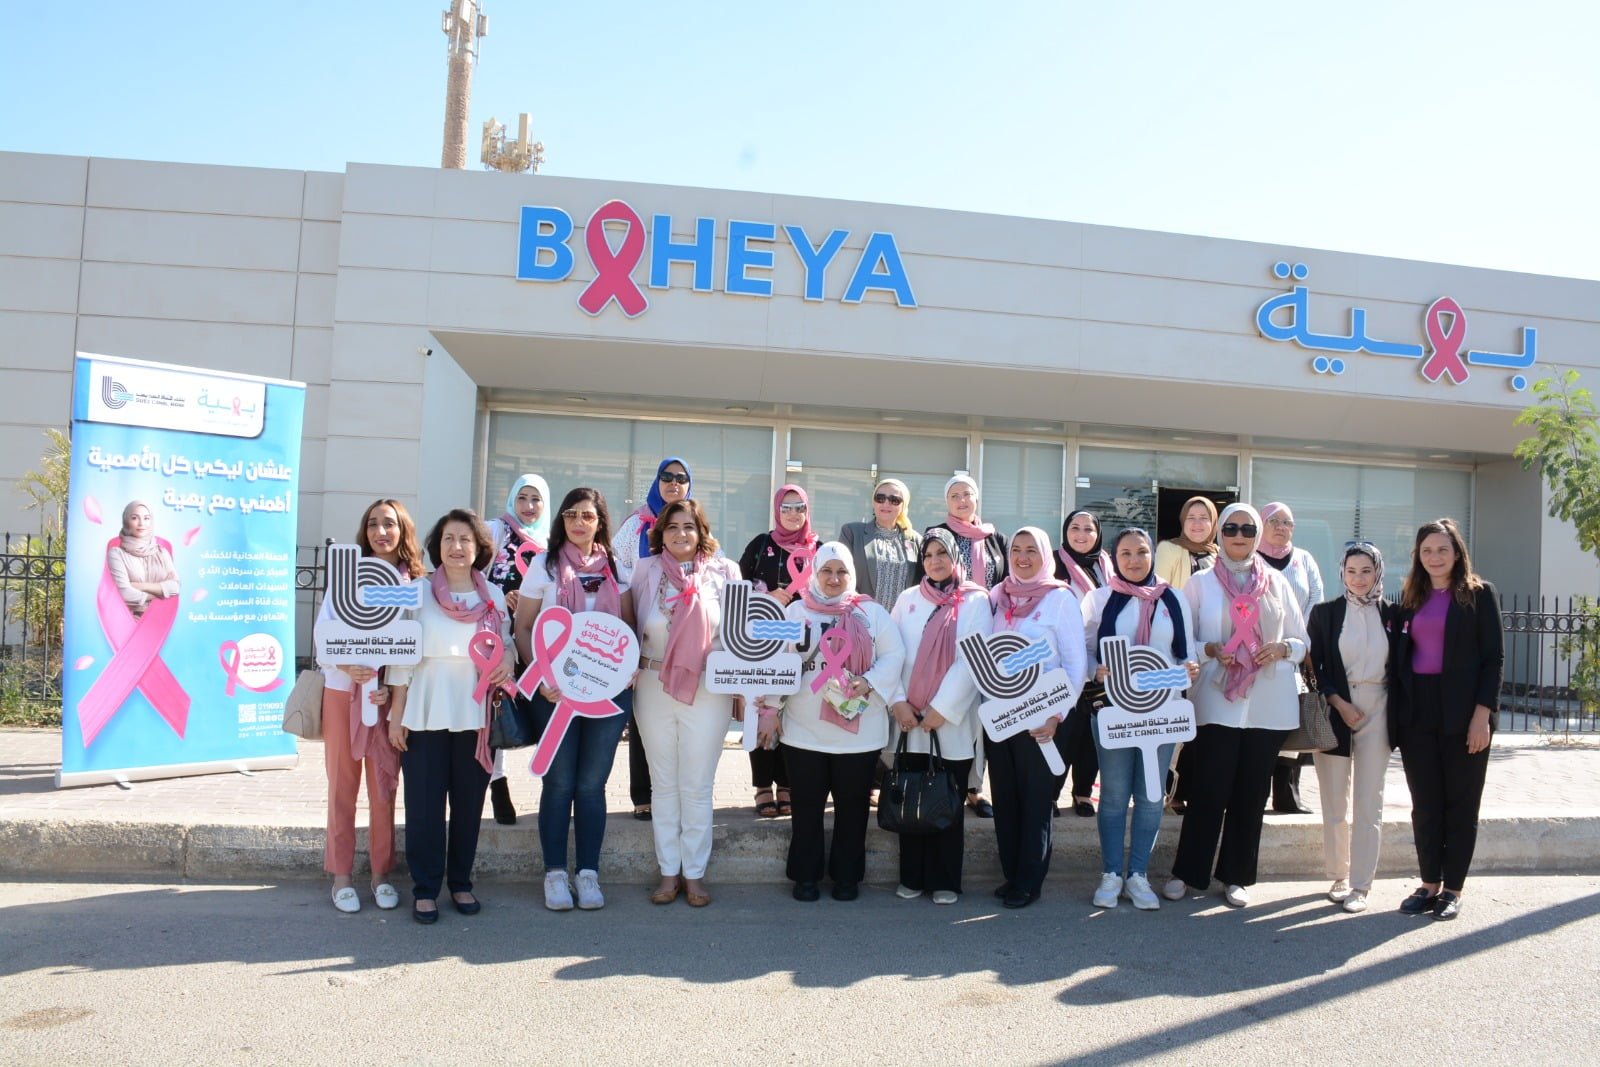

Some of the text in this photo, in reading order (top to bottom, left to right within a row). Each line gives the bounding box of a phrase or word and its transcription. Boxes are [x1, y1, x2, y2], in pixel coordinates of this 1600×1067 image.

[87, 446, 293, 481] علشان ليكي كل الأهمية
[163, 487, 206, 512] بهية
[208, 494, 236, 514] مع
[222, 567, 253, 576] سرطان
[585, 620, 620, 638] أكتوبر
[326, 636, 416, 648] بنك قناة السويس
[581, 630, 615, 647] الوردي
[326, 647, 416, 655] SUEZ CANAL BANK
[715, 667, 796, 678] بنك قناة السويس
[714, 677, 796, 686] SUEZ CANAL BANK
[991, 683, 1068, 724] بنك قناة السويس
[994, 691, 1071, 732] SUEZ CANAL BANK
[1107, 715, 1190, 731] بنك قناة السويس
[1108, 725, 1190, 740] SUEZ CANAL BANK
